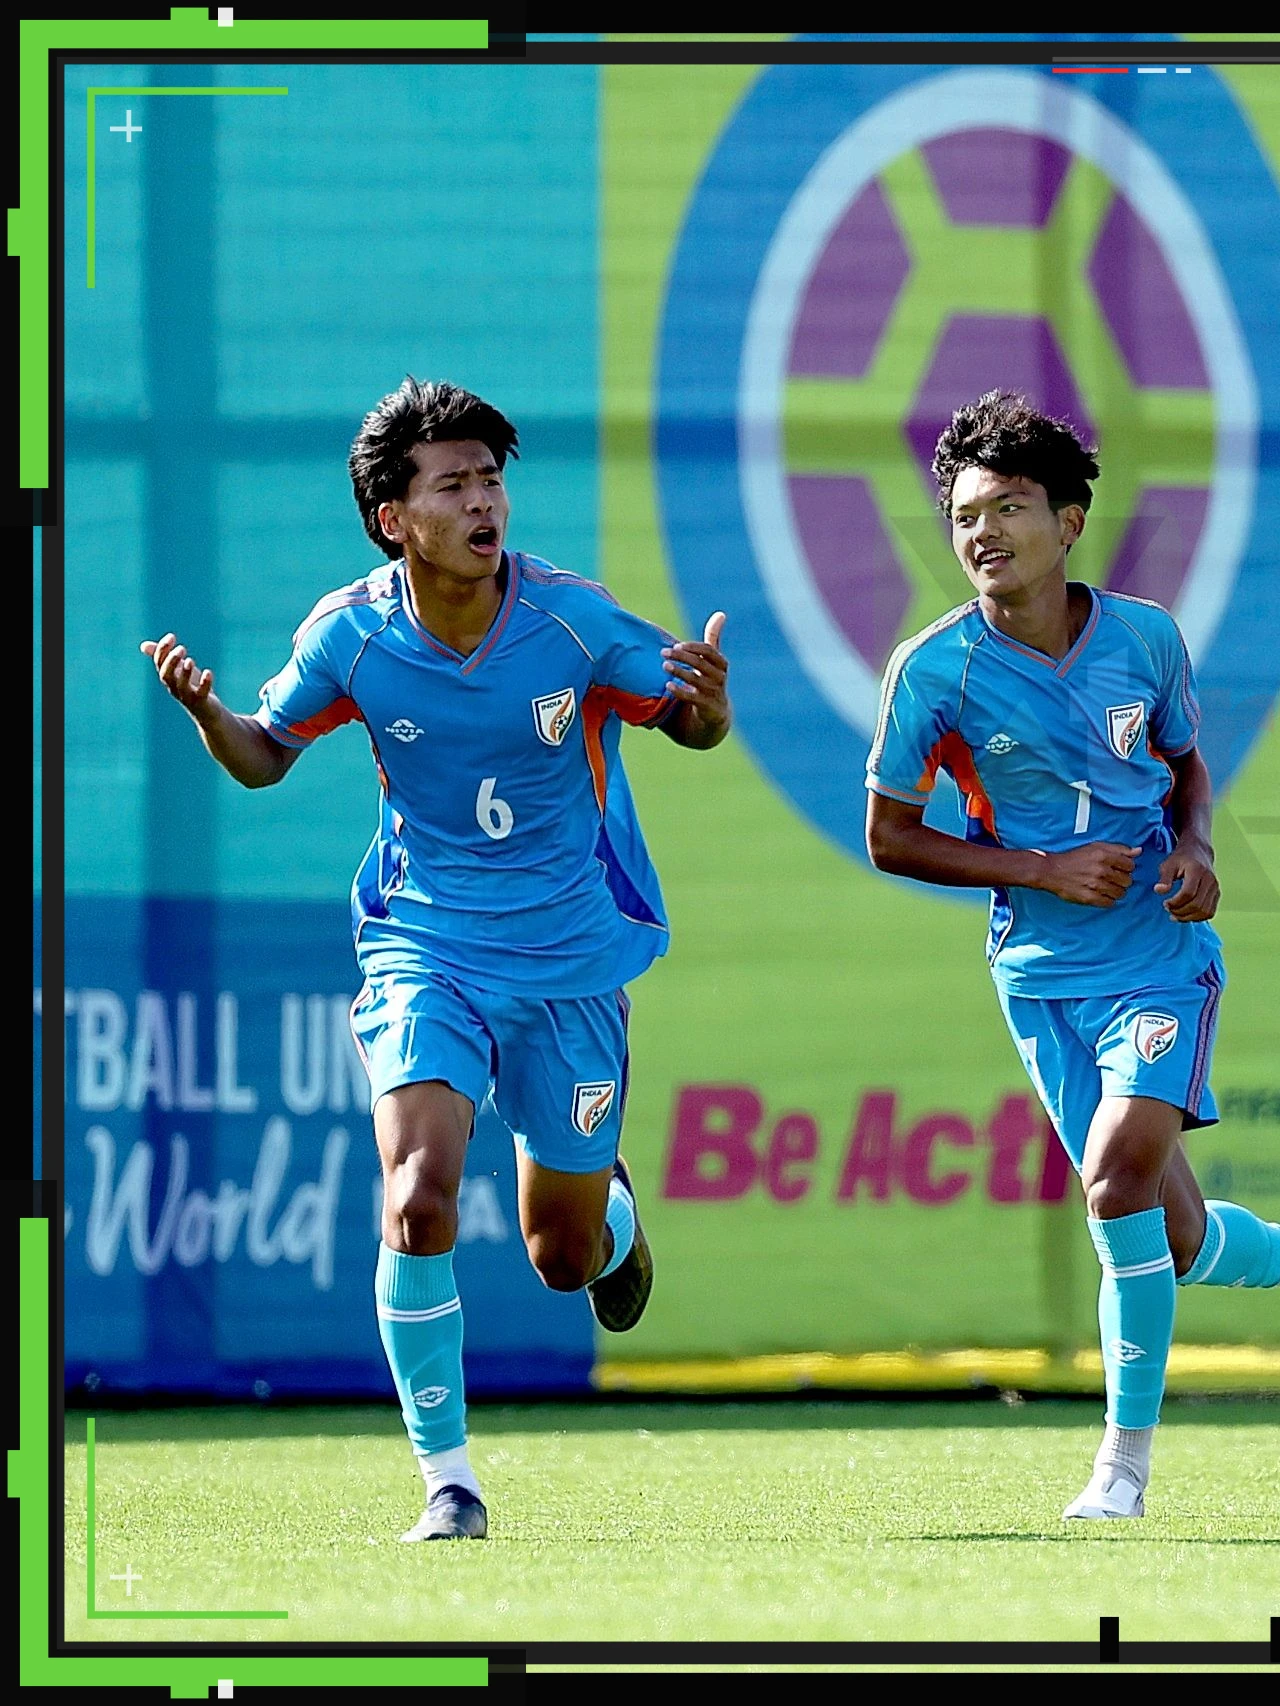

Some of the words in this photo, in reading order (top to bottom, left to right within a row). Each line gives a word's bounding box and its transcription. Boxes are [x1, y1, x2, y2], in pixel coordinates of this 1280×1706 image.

[541, 699, 563, 710] INDIA
[1113, 711, 1134, 721] INDIA
[475, 776, 514, 840] 6
[582, 1089, 603, 1097] INDIA
[663, 1082, 817, 1203] Be
[84, 1114, 350, 1291] World
